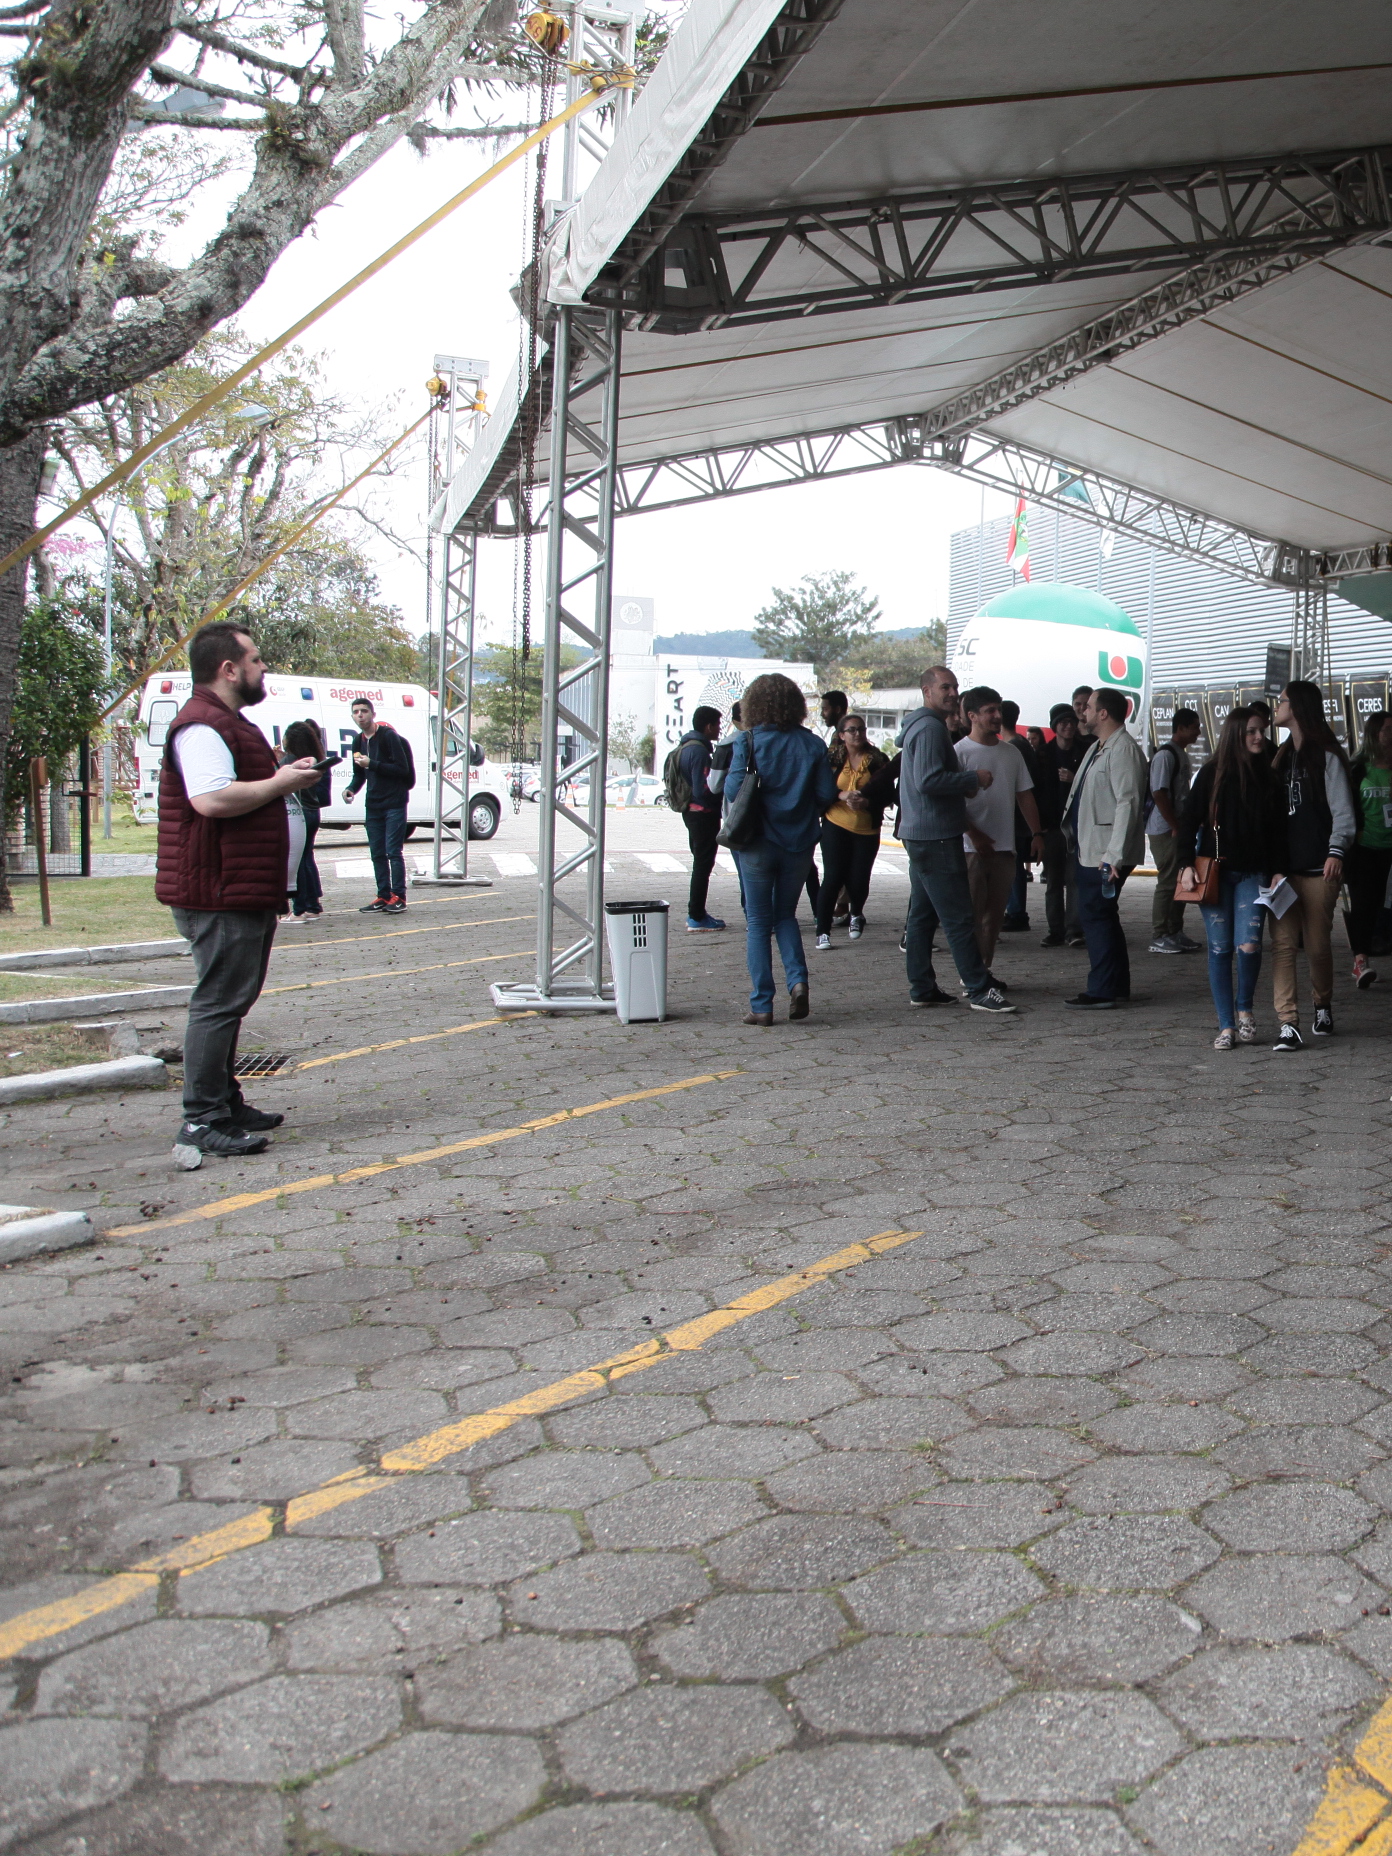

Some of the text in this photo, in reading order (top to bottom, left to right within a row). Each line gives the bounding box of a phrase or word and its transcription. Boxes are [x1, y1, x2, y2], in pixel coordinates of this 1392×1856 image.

[172, 682, 191, 691] HELP
[330, 688, 384, 702] agemed
[665, 664, 684, 744] CEART
[1357, 698, 1383, 713] CERES
[1153, 706, 1174, 719] CEPLAN
[1214, 705, 1230, 718] CAV
